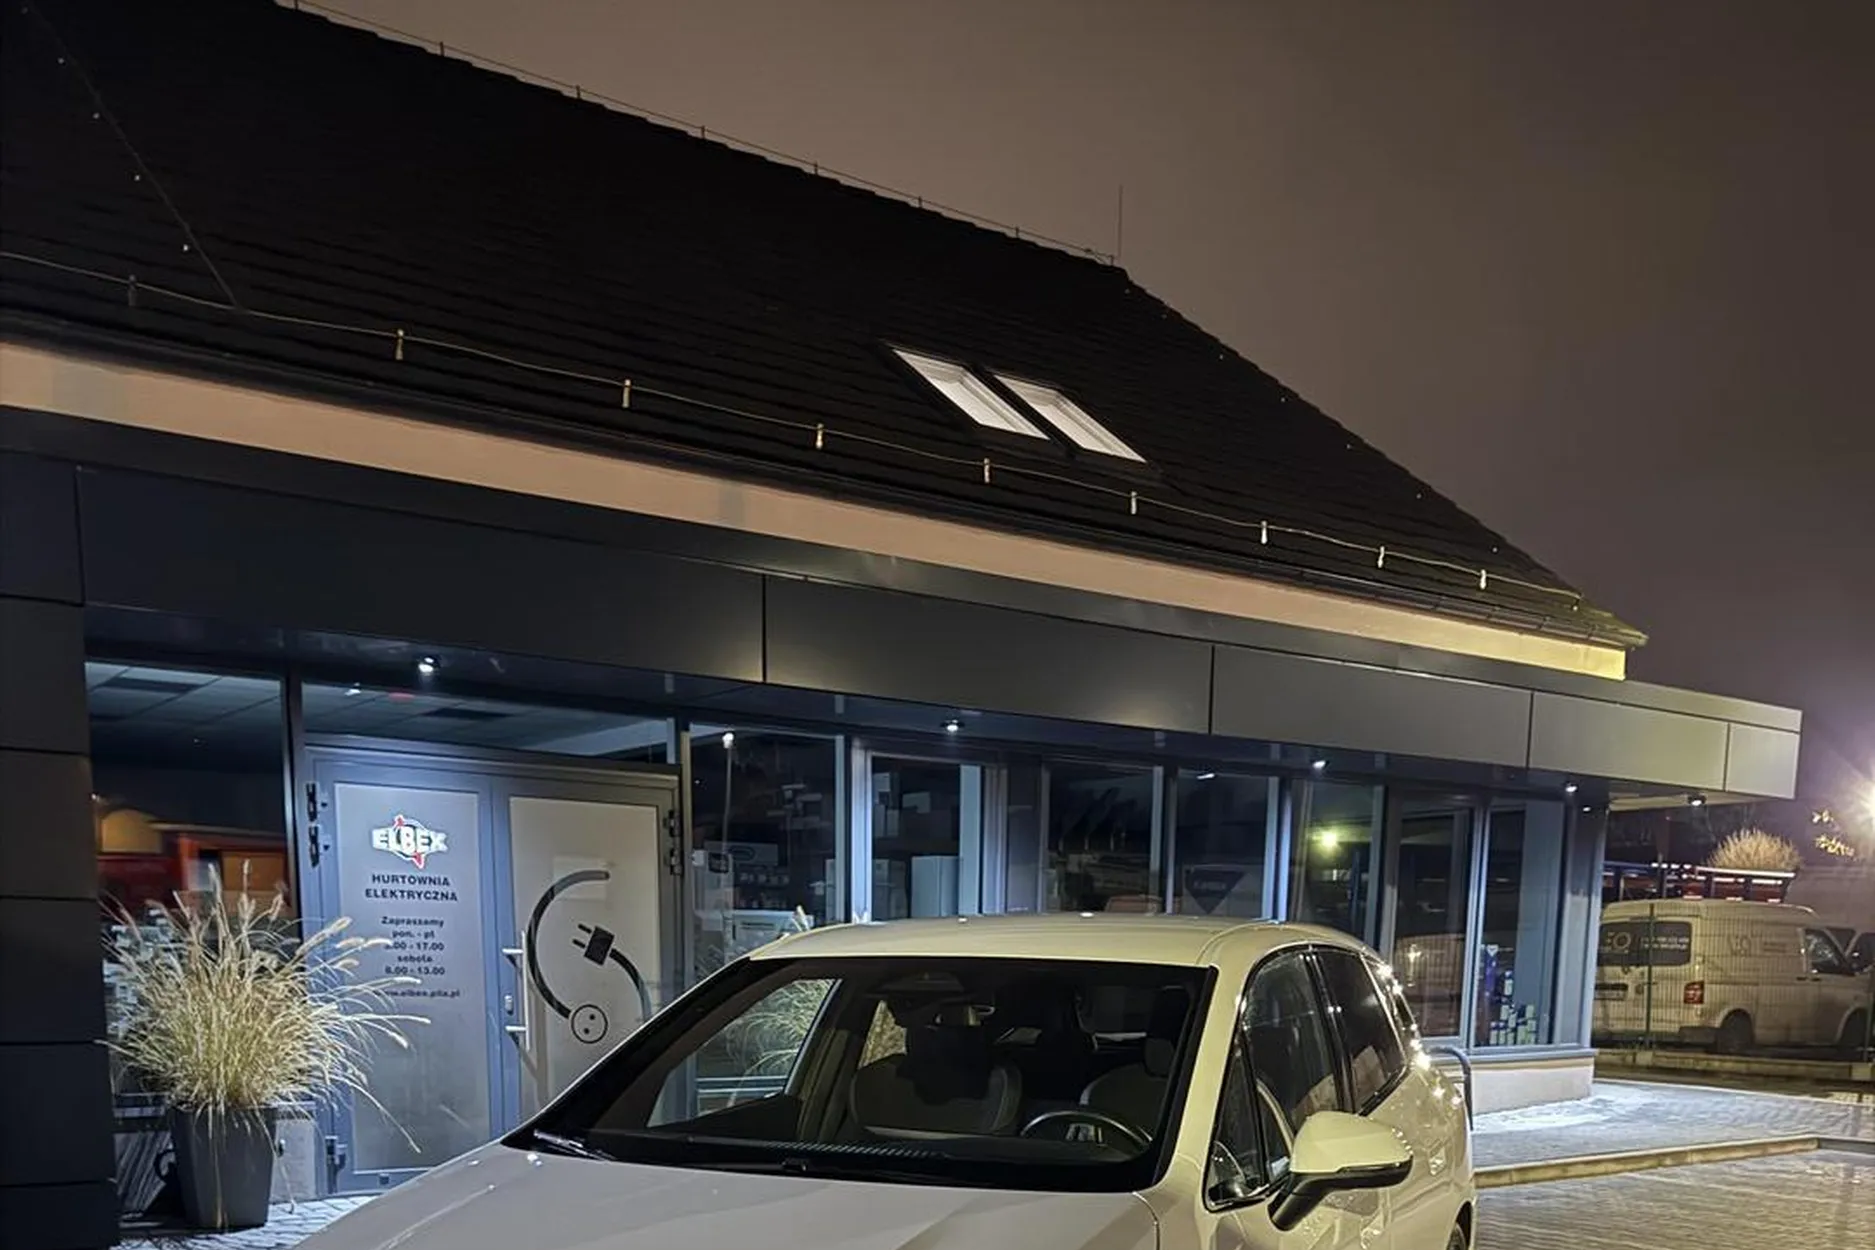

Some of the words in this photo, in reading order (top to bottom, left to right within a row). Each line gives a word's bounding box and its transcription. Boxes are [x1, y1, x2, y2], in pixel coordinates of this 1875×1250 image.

[372, 825, 448, 855] ELBEX
[371, 874, 450, 887] HURTOWNIA
[365, 888, 458, 902] ELEKTRYCZNA
[381, 916, 444, 928] Zapraszamy
[416, 942, 445, 951] 17.00
